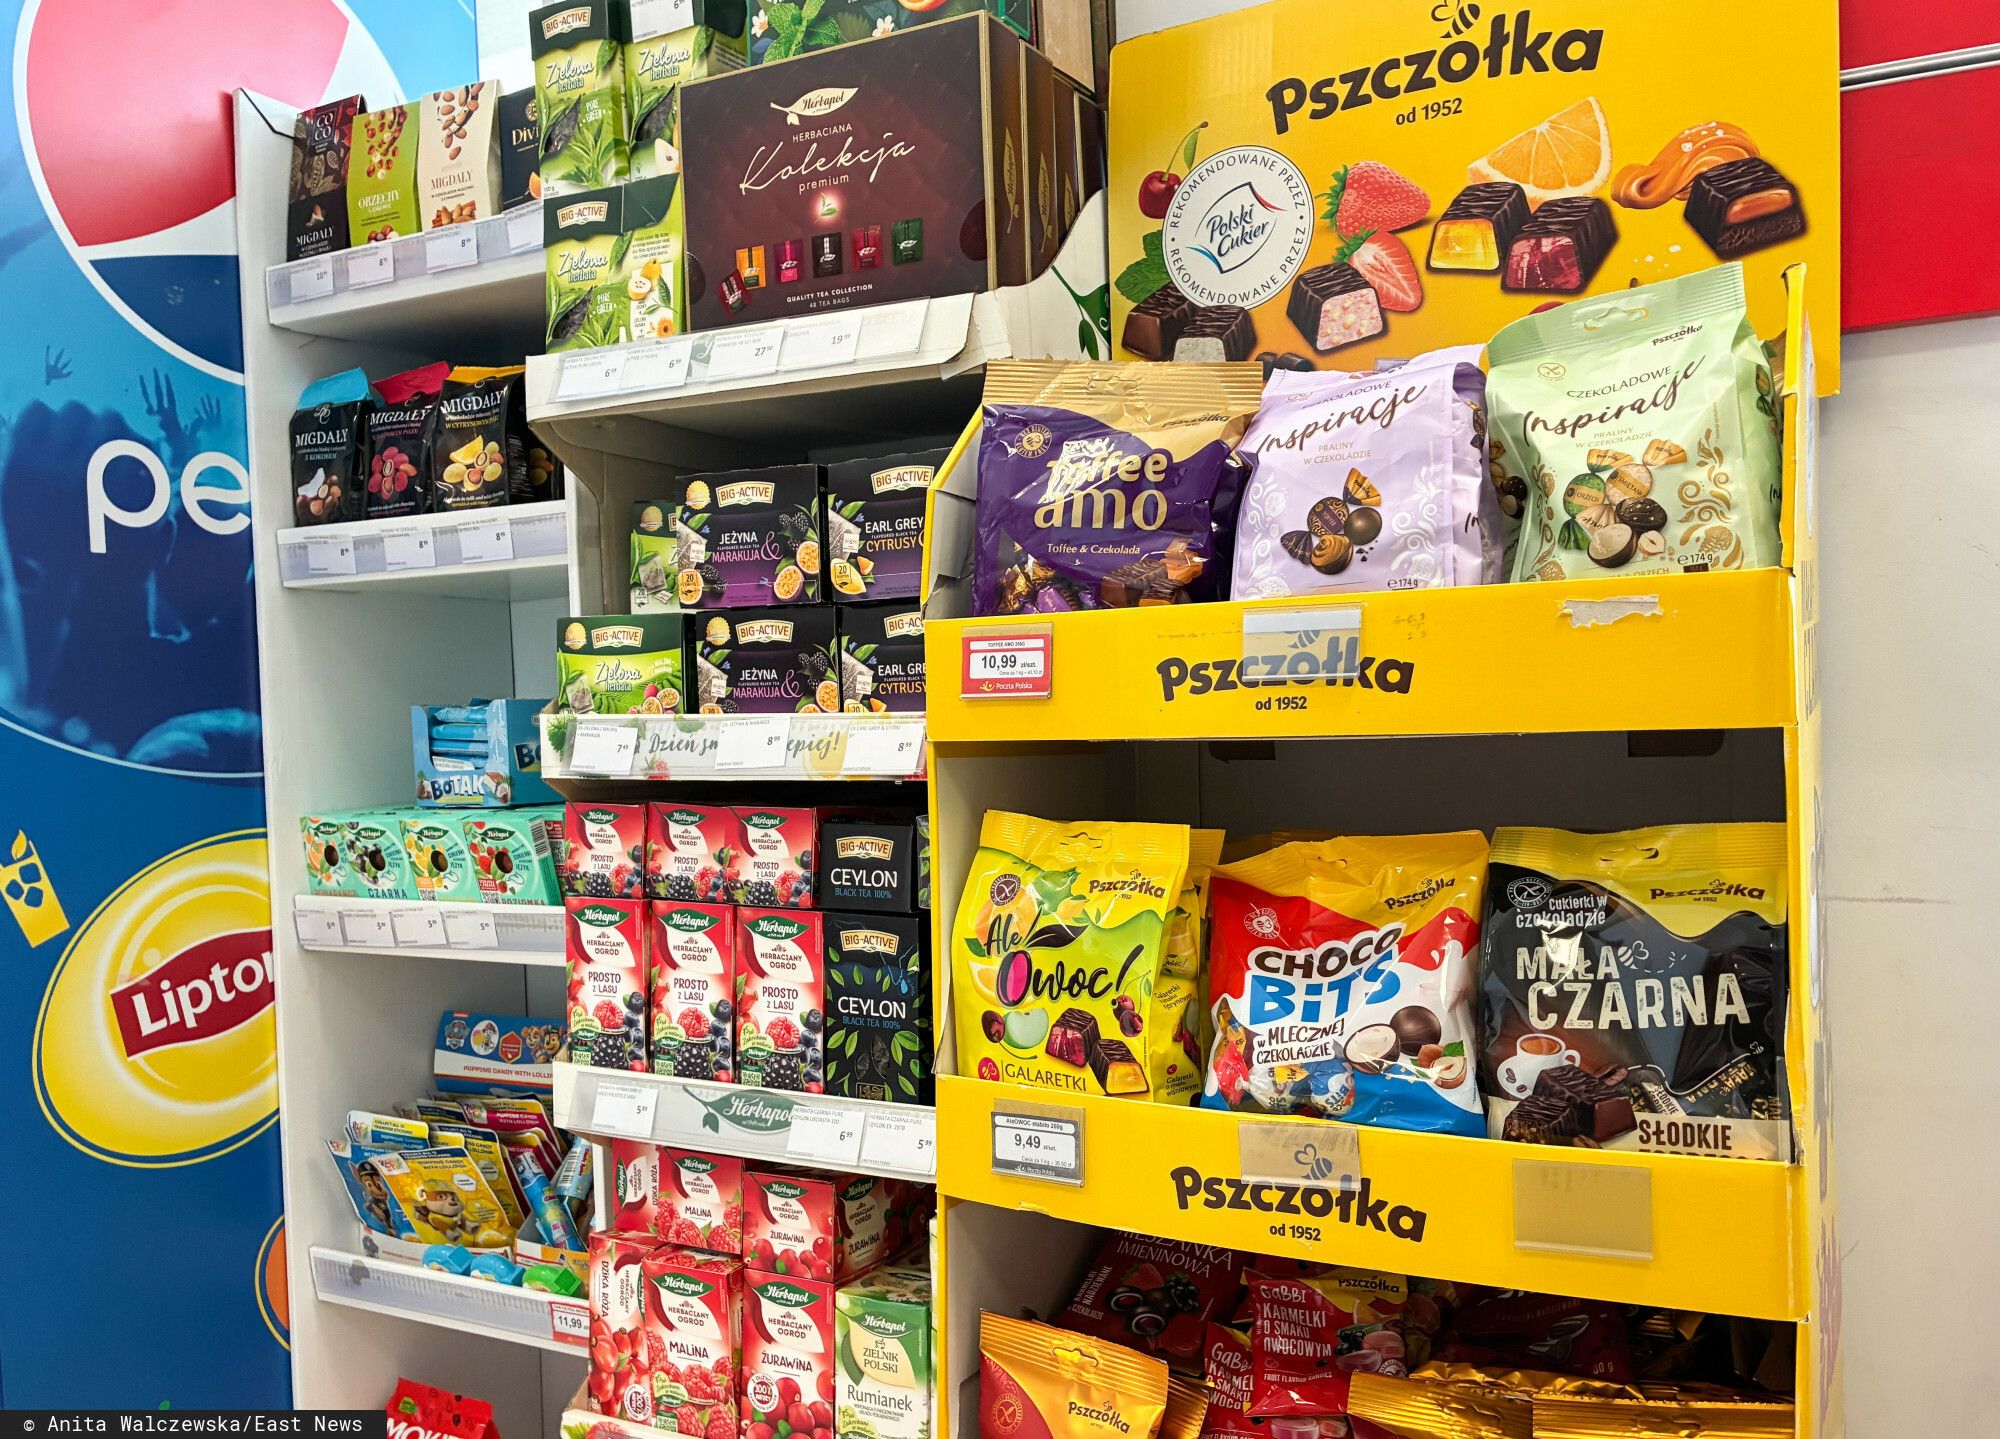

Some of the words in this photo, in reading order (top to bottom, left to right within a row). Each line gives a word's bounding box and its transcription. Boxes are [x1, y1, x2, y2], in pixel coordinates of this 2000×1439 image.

[545, 12, 588, 32] BIG-ACTIVE
[638, 43, 690, 76] Zielona
[546, 56, 594, 88] Zielona
[650, 65, 679, 81] herbata
[558, 77, 584, 92] herbata
[800, 90, 845, 114] Herbapol
[317, 113, 333, 128] CO
[1395, 107, 1417, 126] od
[1421, 98, 1463, 121] 1952
[314, 127, 332, 141] CO
[792, 123, 853, 143] HERBACIANA
[739, 132, 915, 195] Kolekcja
[431, 170, 472, 190] MIGDAŁY
[799, 173, 850, 194] premium
[357, 190, 400, 209] ORZECHY
[1170, 153, 1278, 228] REKOMENDOWANE
[1278, 167, 1306, 210] PRZEZ
[561, 206, 604, 222] BIG-ACTIVE
[1206, 203, 1255, 243] Polski
[296, 226, 334, 246] MIGDAŁY
[1218, 221, 1270, 257] Cukier
[558, 247, 608, 276] Zielona
[1170, 248, 1280, 305] REKOMENDOWANE
[1280, 226, 1306, 274] PRZEZ
[568, 269, 597, 284] herbata
[786, 292, 815, 303] QUALITY
[816, 290, 829, 299] TEA
[831, 284, 873, 297] COLLECTION
[832, 297, 850, 306] BAGS
[1567, 364, 1672, 399] CZEKOLADOWE
[442, 389, 504, 414] MIGDAŁY
[1524, 354, 1707, 446] Inspiracje
[370, 406, 430, 425] MIGDAŁY
[1257, 384, 1428, 455] Inspiracje
[295, 428, 349, 447] MIGDAŁY
[1585, 430, 1655, 448] CZEKOLADZIE
[1594, 426, 1634, 439] PRALINY
[1318, 441, 1355, 452] PRALINY
[1304, 457, 1313, 465] W
[1314, 450, 1372, 464] CZEKOLADZIE
[875, 470, 930, 488] BIG-ACTIVE
[720, 486, 770, 501] BIG-ACTIVE
[1033, 487, 1168, 531] amo
[865, 520, 892, 534] EARL
[895, 517, 925, 531] GREY
[719, 531, 758, 545] JEŻYNA
[761, 530, 784, 561] &
[866, 535, 917, 553] CYTRUSY
[1046, 544, 1078, 554] Toffee
[1080, 545, 1088, 553] &
[1090, 544, 1140, 554] Czekolada
[712, 551, 760, 563] MARAKUJA
[1690, 553, 1706, 564] 174
[1708, 554, 1713, 565] g
[686, 574, 694, 583] 20
[838, 566, 848, 574] 20
[1399, 578, 1412, 588] 174
[594, 633, 640, 643] BIG-ACTIVE
[740, 624, 790, 638] BIG-ACTIVE
[594, 659, 643, 684] Zielona
[878, 665, 905, 676] EARL
[907, 663, 927, 674] GRE
[981, 654, 1017, 672] 10,99
[605, 680, 632, 692] herbata
[739, 668, 778, 681] JEŻYNA
[780, 669, 804, 699] &
[733, 687, 781, 699] MARAKUJA
[1255, 698, 1272, 711] od
[1274, 696, 1308, 711] 1952
[650, 733, 699, 754] Dzień
[840, 841, 890, 855] BIG-ACTIVE
[591, 854, 614, 863] PROSTO
[598, 863, 611, 871] LASU
[674, 856, 699, 865] PROSTO
[753, 862, 780, 871] PROSTO
[680, 865, 696, 873] LASU
[761, 870, 776, 878] LASU
[830, 868, 898, 889] CEYLON
[368, 888, 408, 899] CZARNA
[834, 888, 857, 897] BLACK
[858, 889, 872, 898] TEA
[874, 889, 893, 899] 100%
[1597, 894, 1608, 907] w
[844, 934, 895, 950] BIG-ACTIVE
[984, 914, 1023, 957] Ale
[1254, 927, 1403, 979] CHOCO
[1516, 945, 1620, 981] MAŁA
[588, 971, 622, 984] PROSTO
[674, 978, 709, 992] PROSTO
[997, 944, 1145, 1008] Owoc!
[598, 984, 618, 994] LASU
[684, 991, 705, 1002] LASU
[762, 986, 799, 1000] PROSTO
[772, 1000, 795, 1011] LASU
[837, 996, 907, 1020] CEYLON
[1527, 972, 1751, 1031] CZARNA
[842, 1016, 865, 1027] BLACK
[866, 1018, 881, 1028] TEA
[882, 1020, 901, 1030] 100%
[1258, 1040, 1266, 1048] w
[1268, 1018, 1345, 1045] MLECZNEJ
[1256, 1042, 1332, 1065] CZEKOLADZIE
[532, 1070, 553, 1079] LOLLI
[1006, 1063, 1087, 1092] GALARETKI
[723, 1094, 794, 1127] Herbapol
[1014, 1133, 1041, 1150] 9,49
[1638, 1119, 1732, 1151] SŁODKIE
[1270, 1224, 1286, 1237] od
[1288, 1224, 1322, 1242] 1952
[1117, 1240, 1211, 1279] IMIENINOWA
[661, 1274, 704, 1295] Herbapol
[764, 1283, 809, 1305] Herbapol
[601, 1292, 610, 1318] RÓŻA
[558, 1315, 582, 1329] 11,99
[862, 1314, 907, 1332] Herbapol
[1263, 1302, 1326, 1328] KARMELKI
[1264, 1320, 1271, 1334] O
[1274, 1321, 1311, 1339] SMAKU
[863, 1347, 899, 1363] ZIELNIK
[1263, 1338, 1332, 1358] OWOCOWYM
[864, 1358, 898, 1374] POLSKI
[847, 1384, 913, 1412] Rumianek
